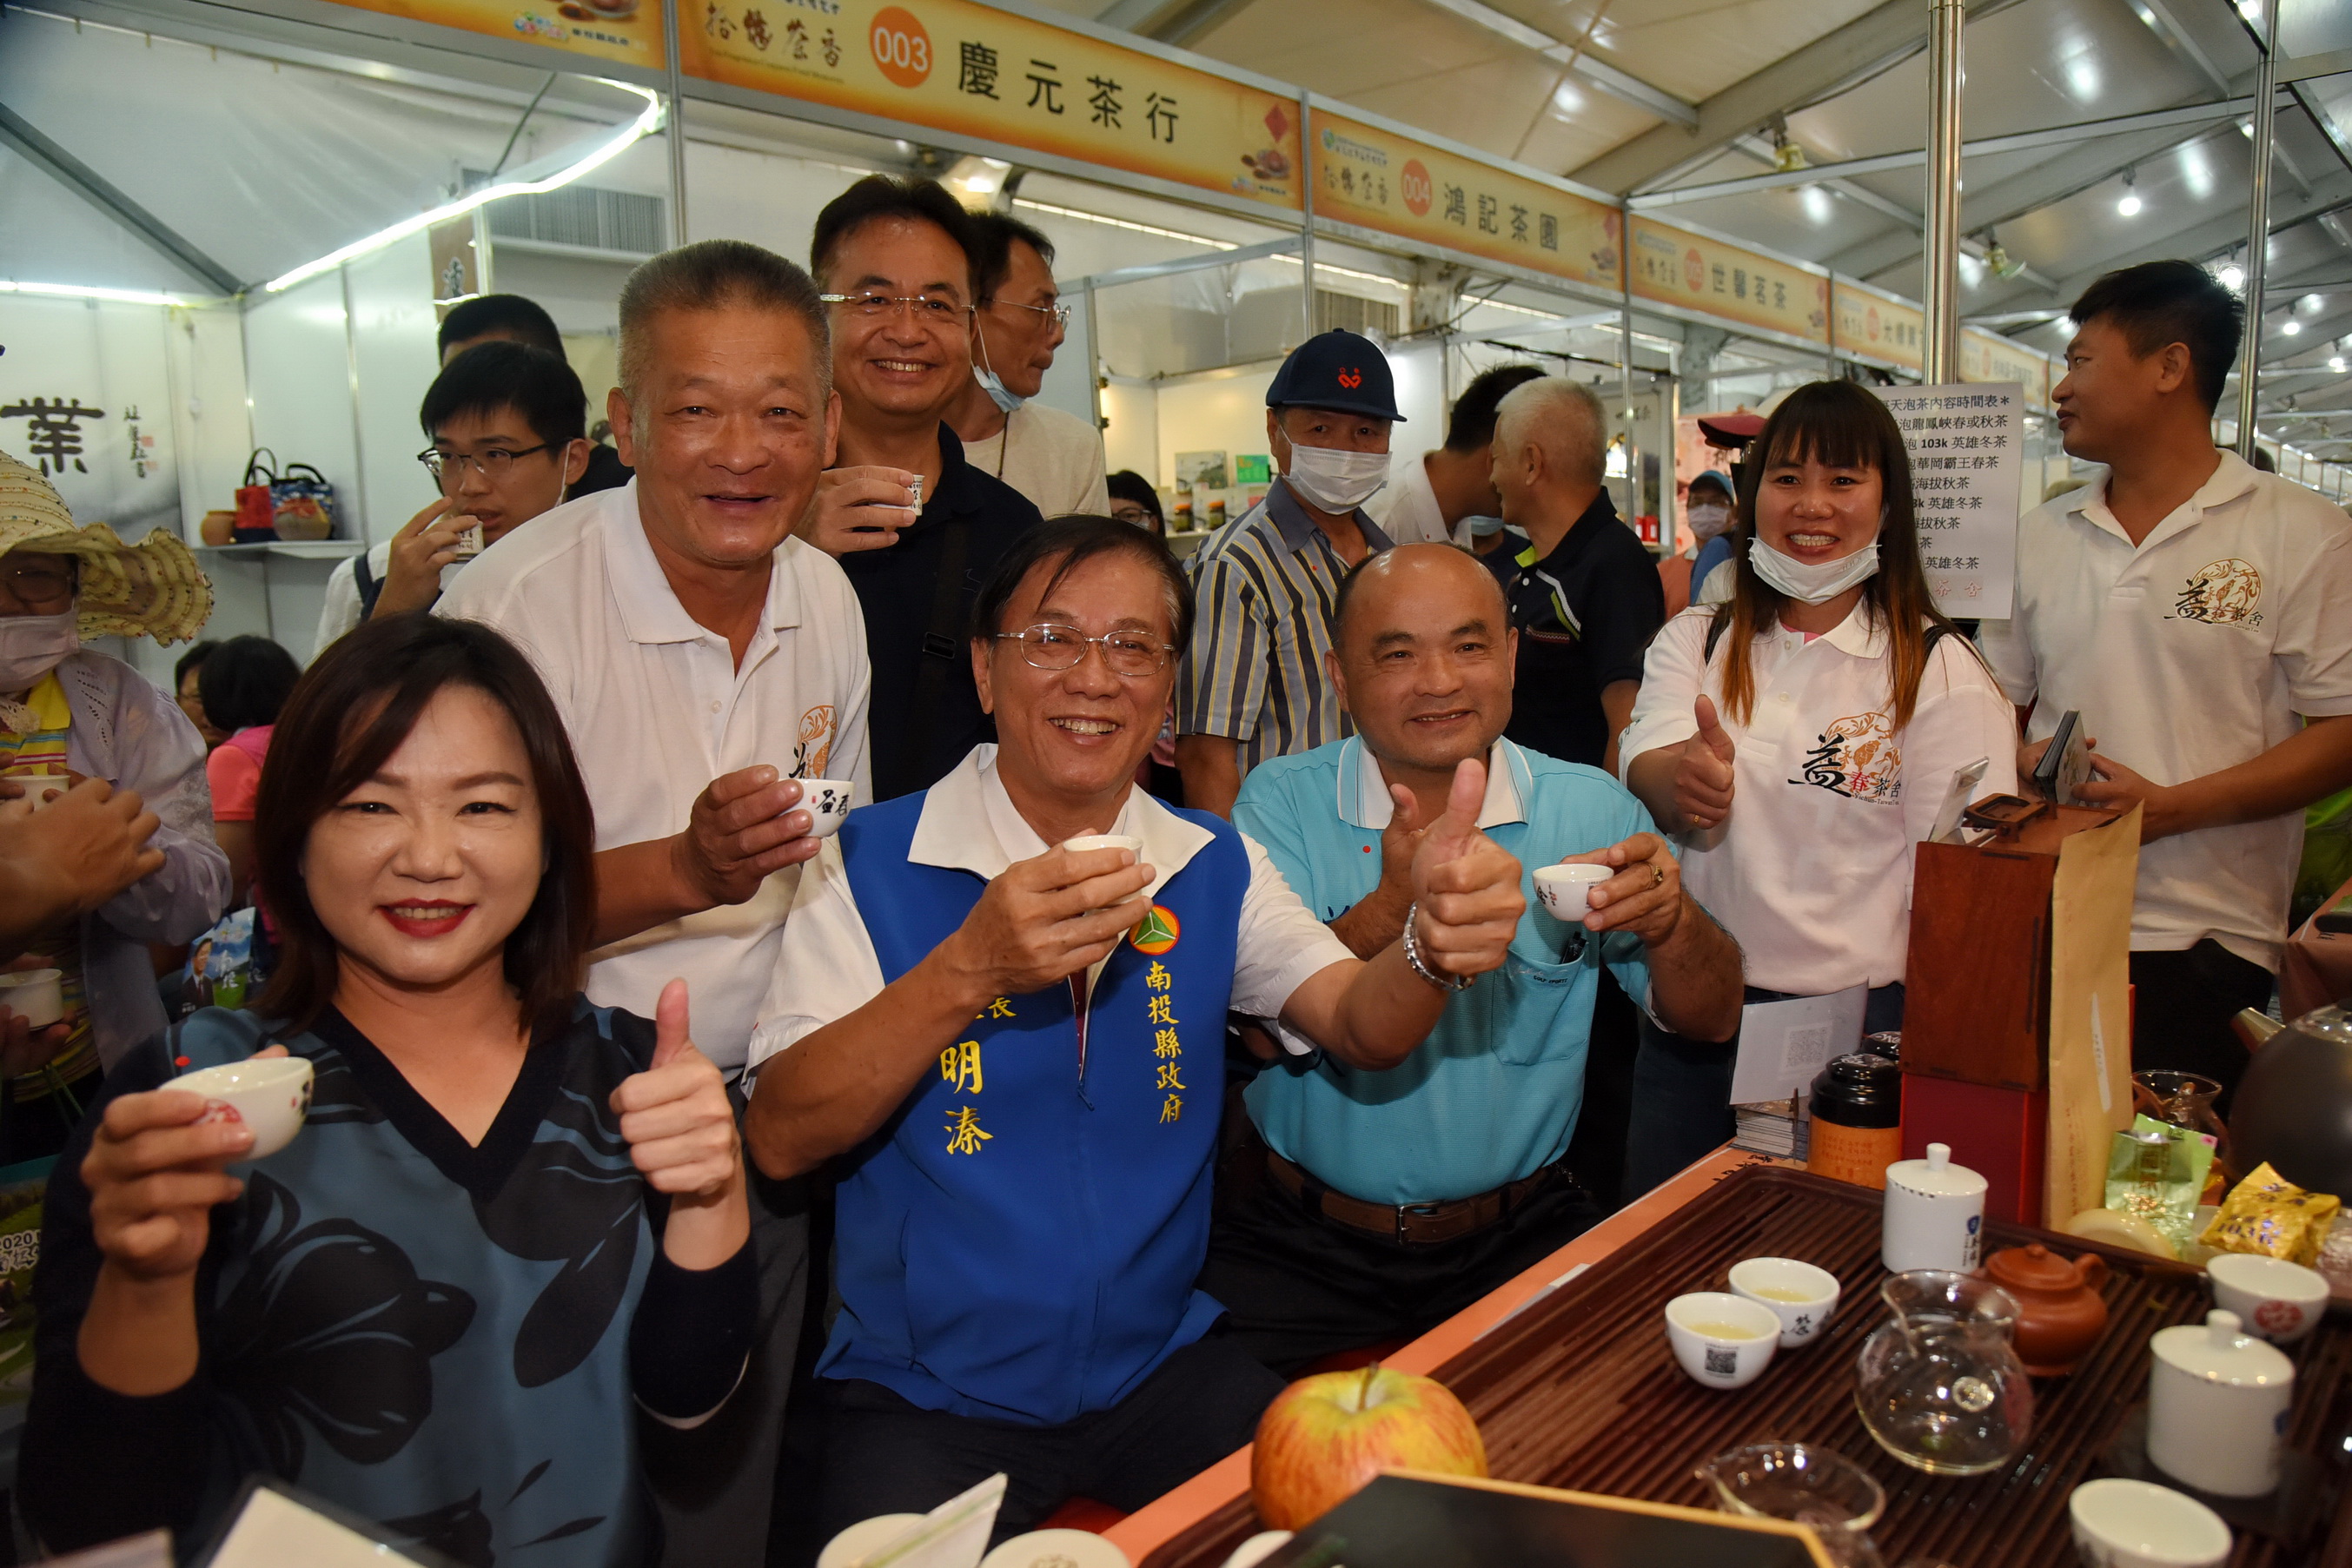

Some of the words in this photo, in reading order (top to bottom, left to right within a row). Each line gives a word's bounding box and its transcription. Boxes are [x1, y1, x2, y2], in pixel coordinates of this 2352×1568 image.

[874, 27, 928, 72] 003
[958, 40, 1179, 143] 慶元茶行
[1403, 173, 1431, 205] 004
[1444, 182, 1558, 252] 鴻記茶園
[1921, 437, 1948, 449] 103k
[1951, 435, 2007, 450] 英雄冬茶
[1928, 496, 1983, 510] 英雄冬茶
[1919, 536, 1933, 549] 茶
[1925, 556, 1980, 570] 英雄冬茶
[1145, 960, 1187, 1124] 南投縣政府
[0, 1232, 33, 1251] 020
